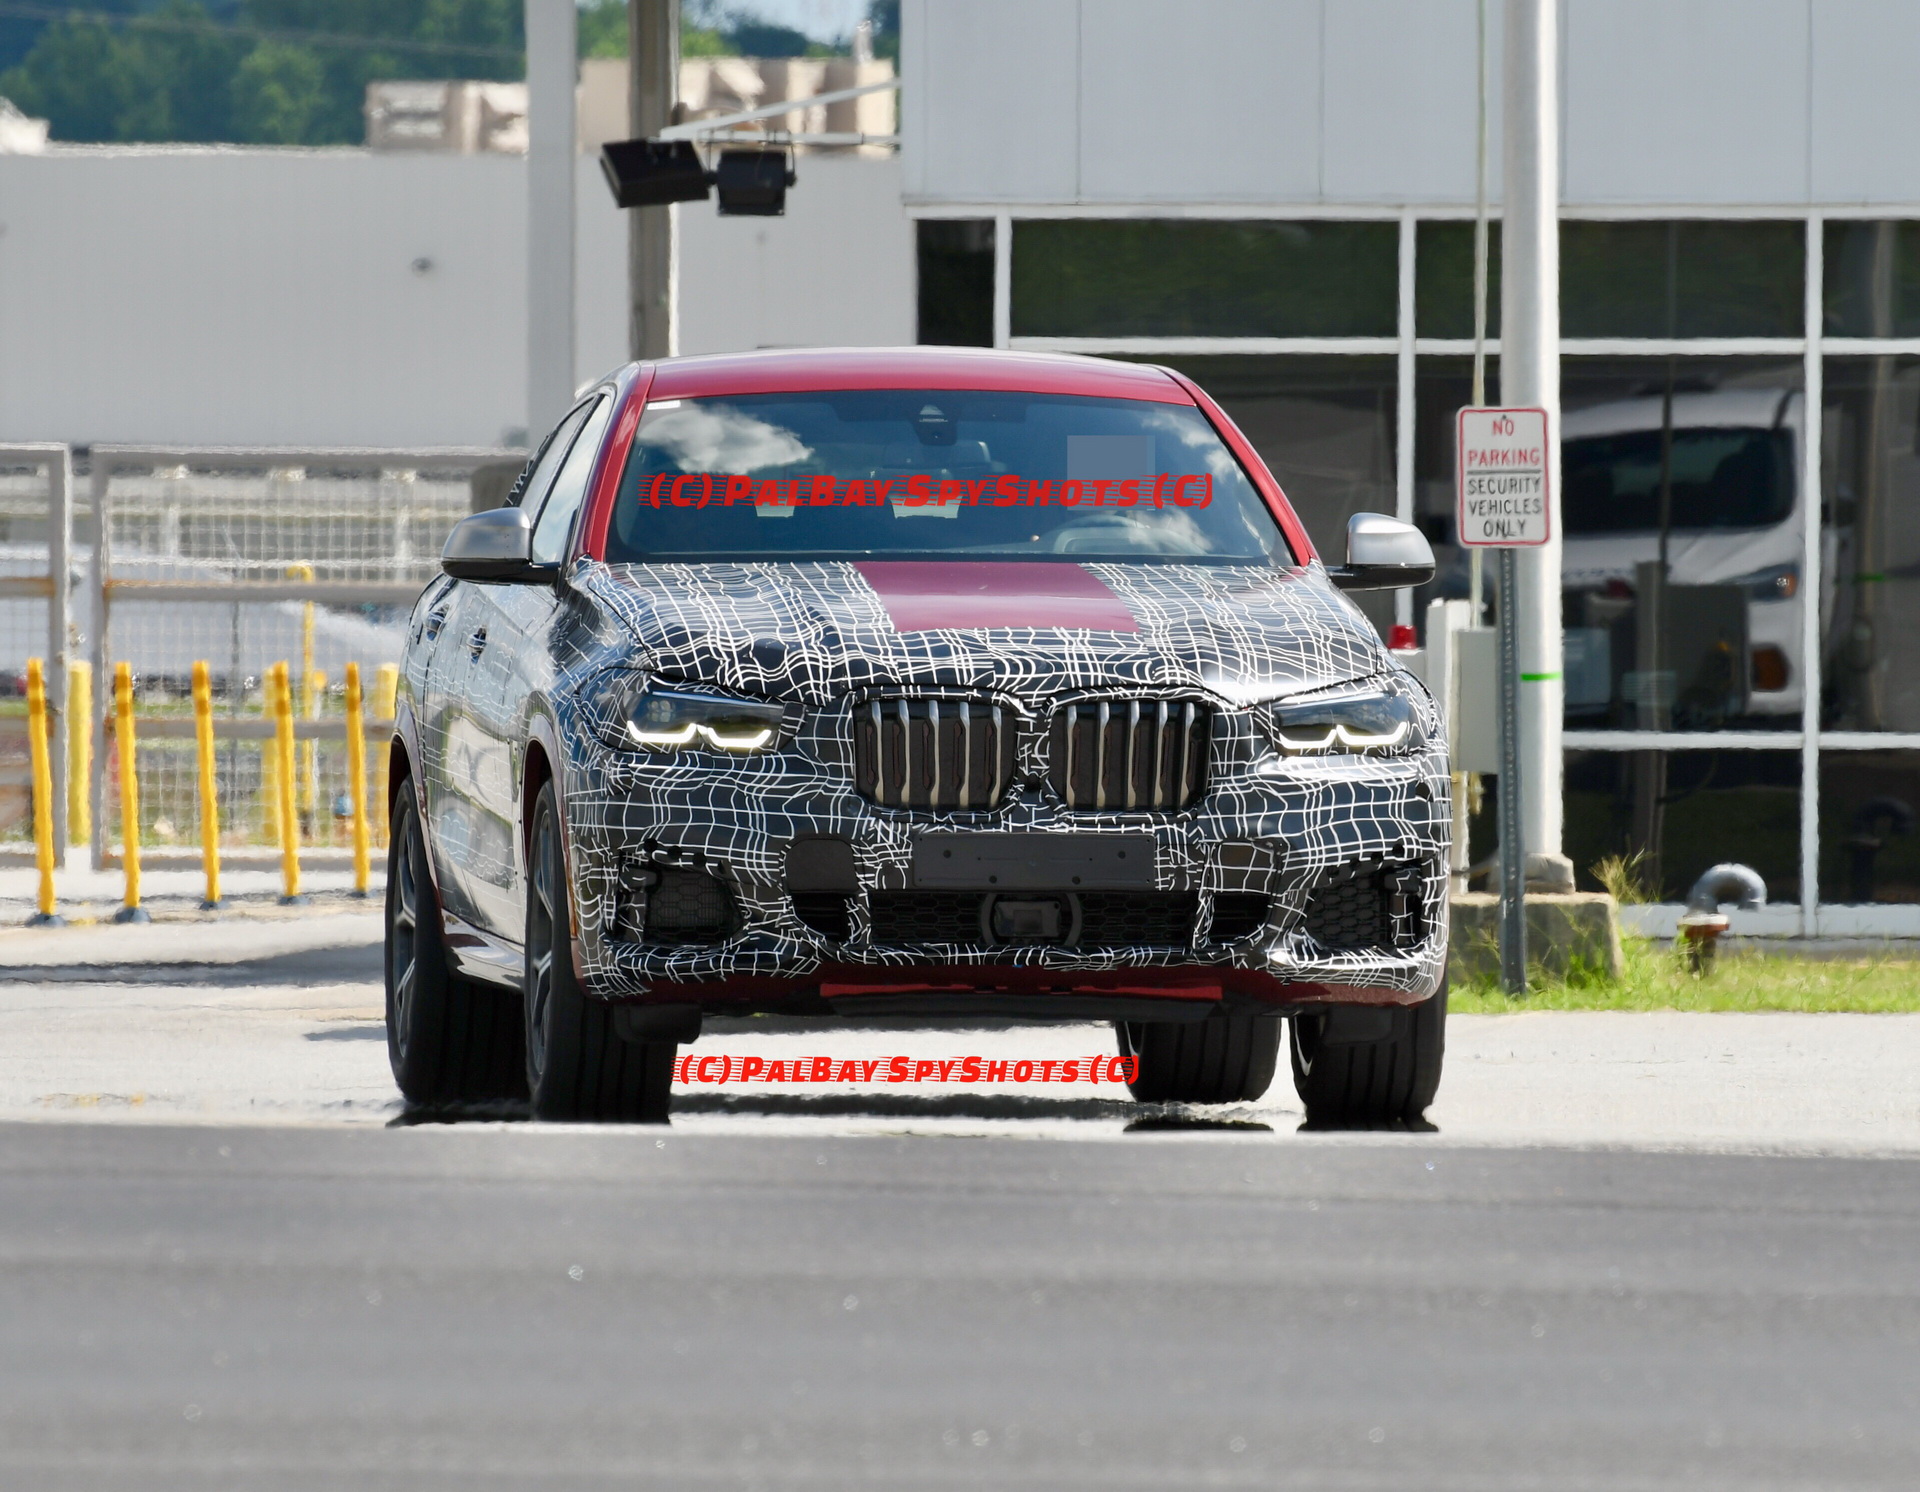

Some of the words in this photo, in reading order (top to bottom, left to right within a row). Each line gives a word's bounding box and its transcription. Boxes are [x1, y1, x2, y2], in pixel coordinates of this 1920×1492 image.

[1492, 419, 1515, 436] NO
[1467, 447, 1541, 467] PARKING
[1467, 476, 1541, 496] SECURITY
[1468, 499, 1542, 517] VEHICLES
[1483, 518, 1526, 538] ONLY
